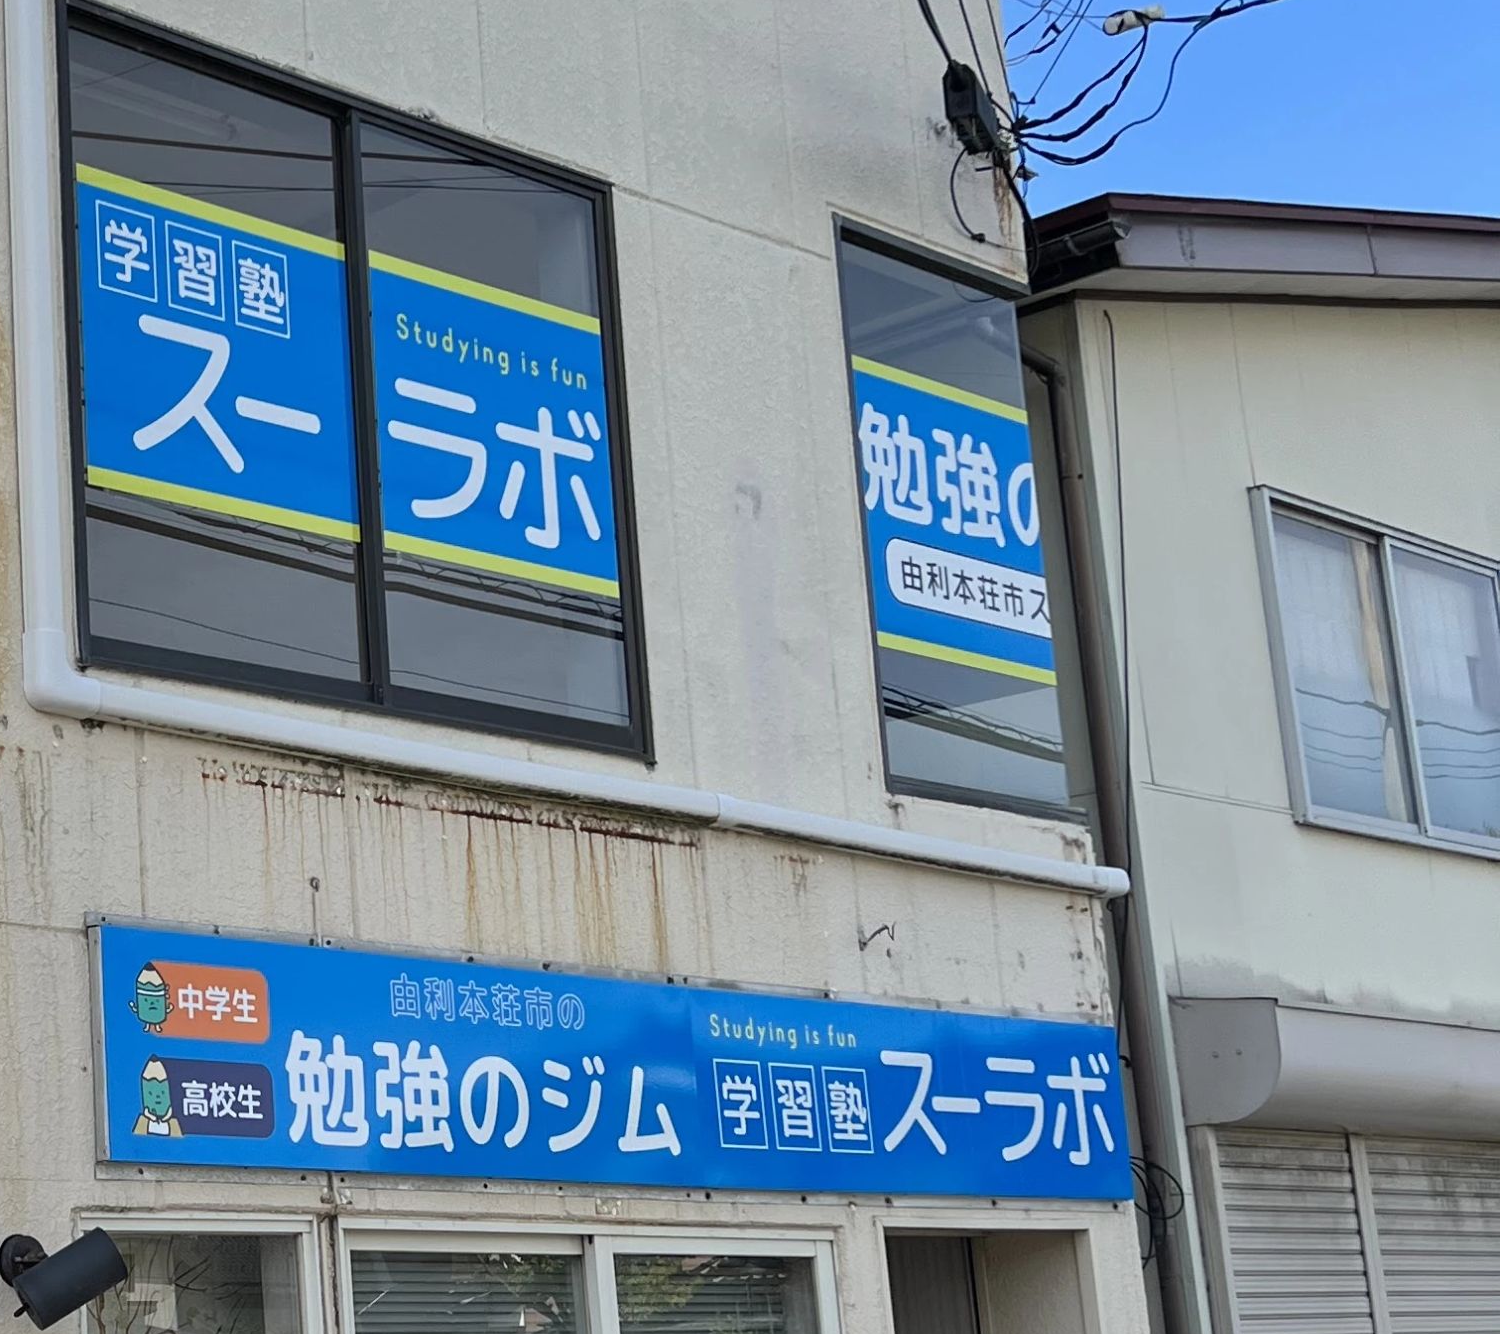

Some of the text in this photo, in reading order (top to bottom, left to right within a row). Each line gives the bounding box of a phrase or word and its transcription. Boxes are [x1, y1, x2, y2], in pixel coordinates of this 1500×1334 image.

[104, 219, 285, 325] 学習塾
[396, 313, 588, 391] Studying is fun
[133, 314, 601, 550] スーラボ
[901, 556, 1052, 625] 由利本荘市ス
[177, 983, 258, 1023] 中学生
[389, 972, 585, 1031] 由利本荘市の
[709, 1013, 857, 1049] Studying is fun
[181, 1080, 264, 1120] 高校生
[285, 1029, 1115, 1166] 勉強のジム 学習塾 スーラボ
